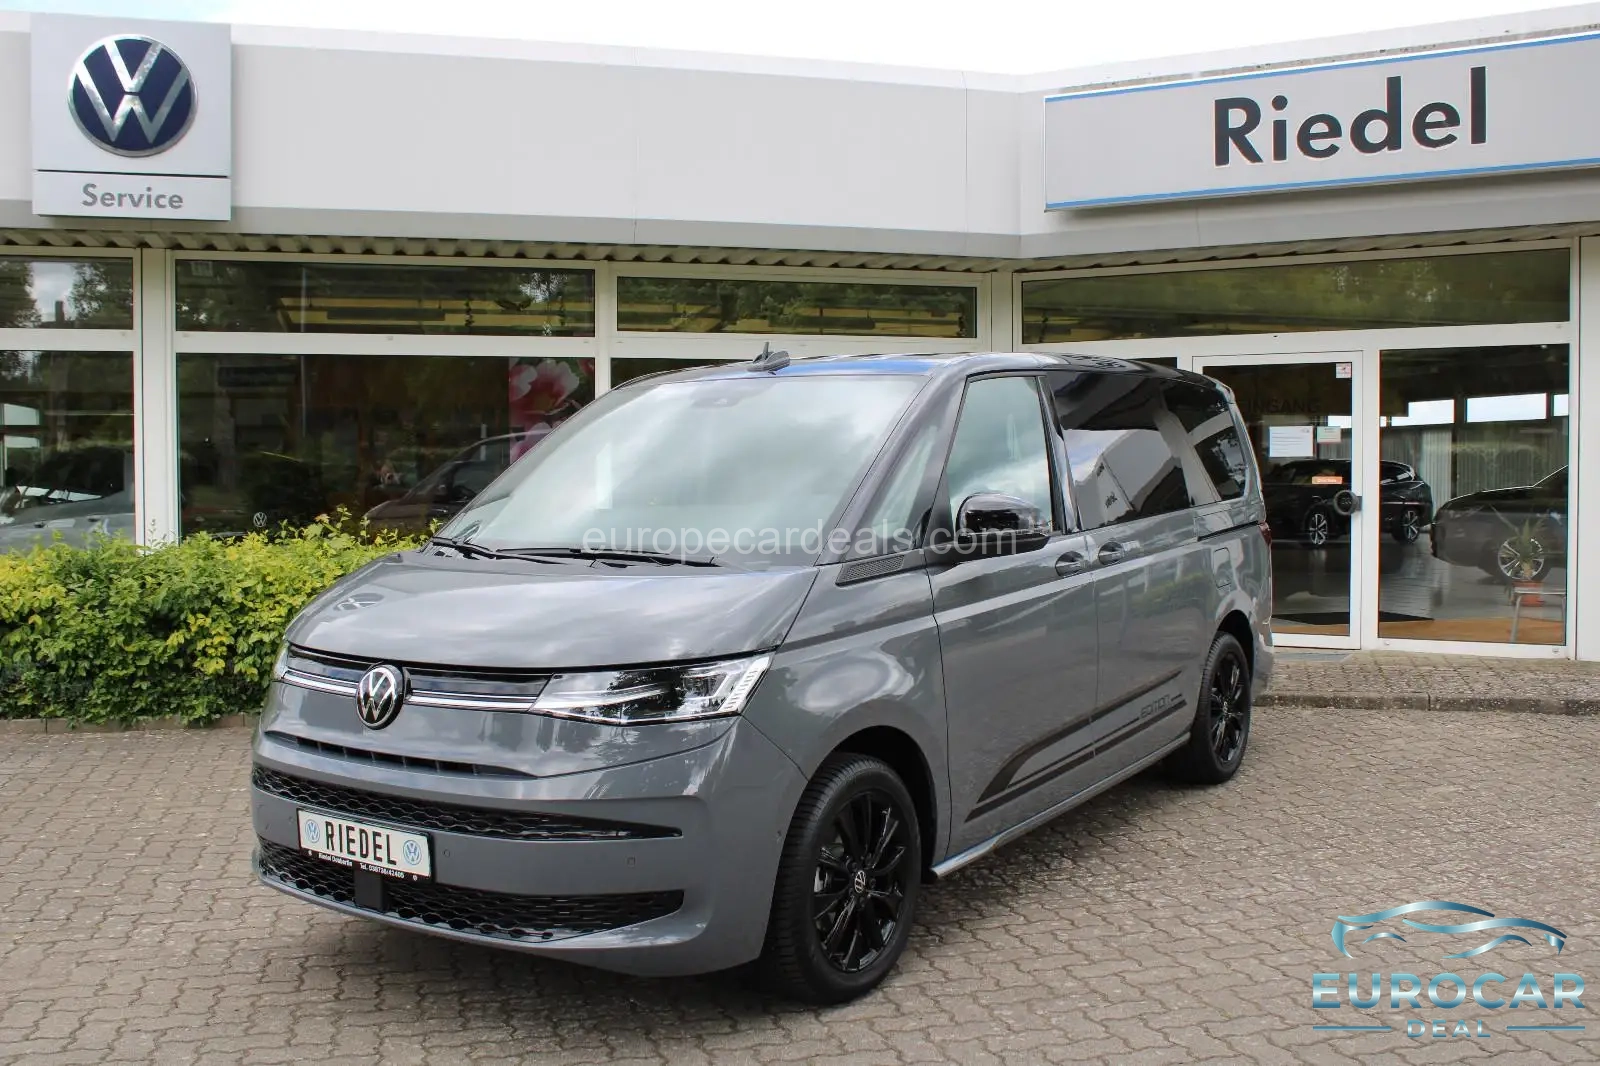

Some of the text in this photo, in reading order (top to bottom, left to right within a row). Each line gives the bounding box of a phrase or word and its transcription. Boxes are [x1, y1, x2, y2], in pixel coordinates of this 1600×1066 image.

[1214, 66, 1487, 167] Riedel
[81, 182, 184, 210] Service
[324, 820, 398, 866] RIEDEL
